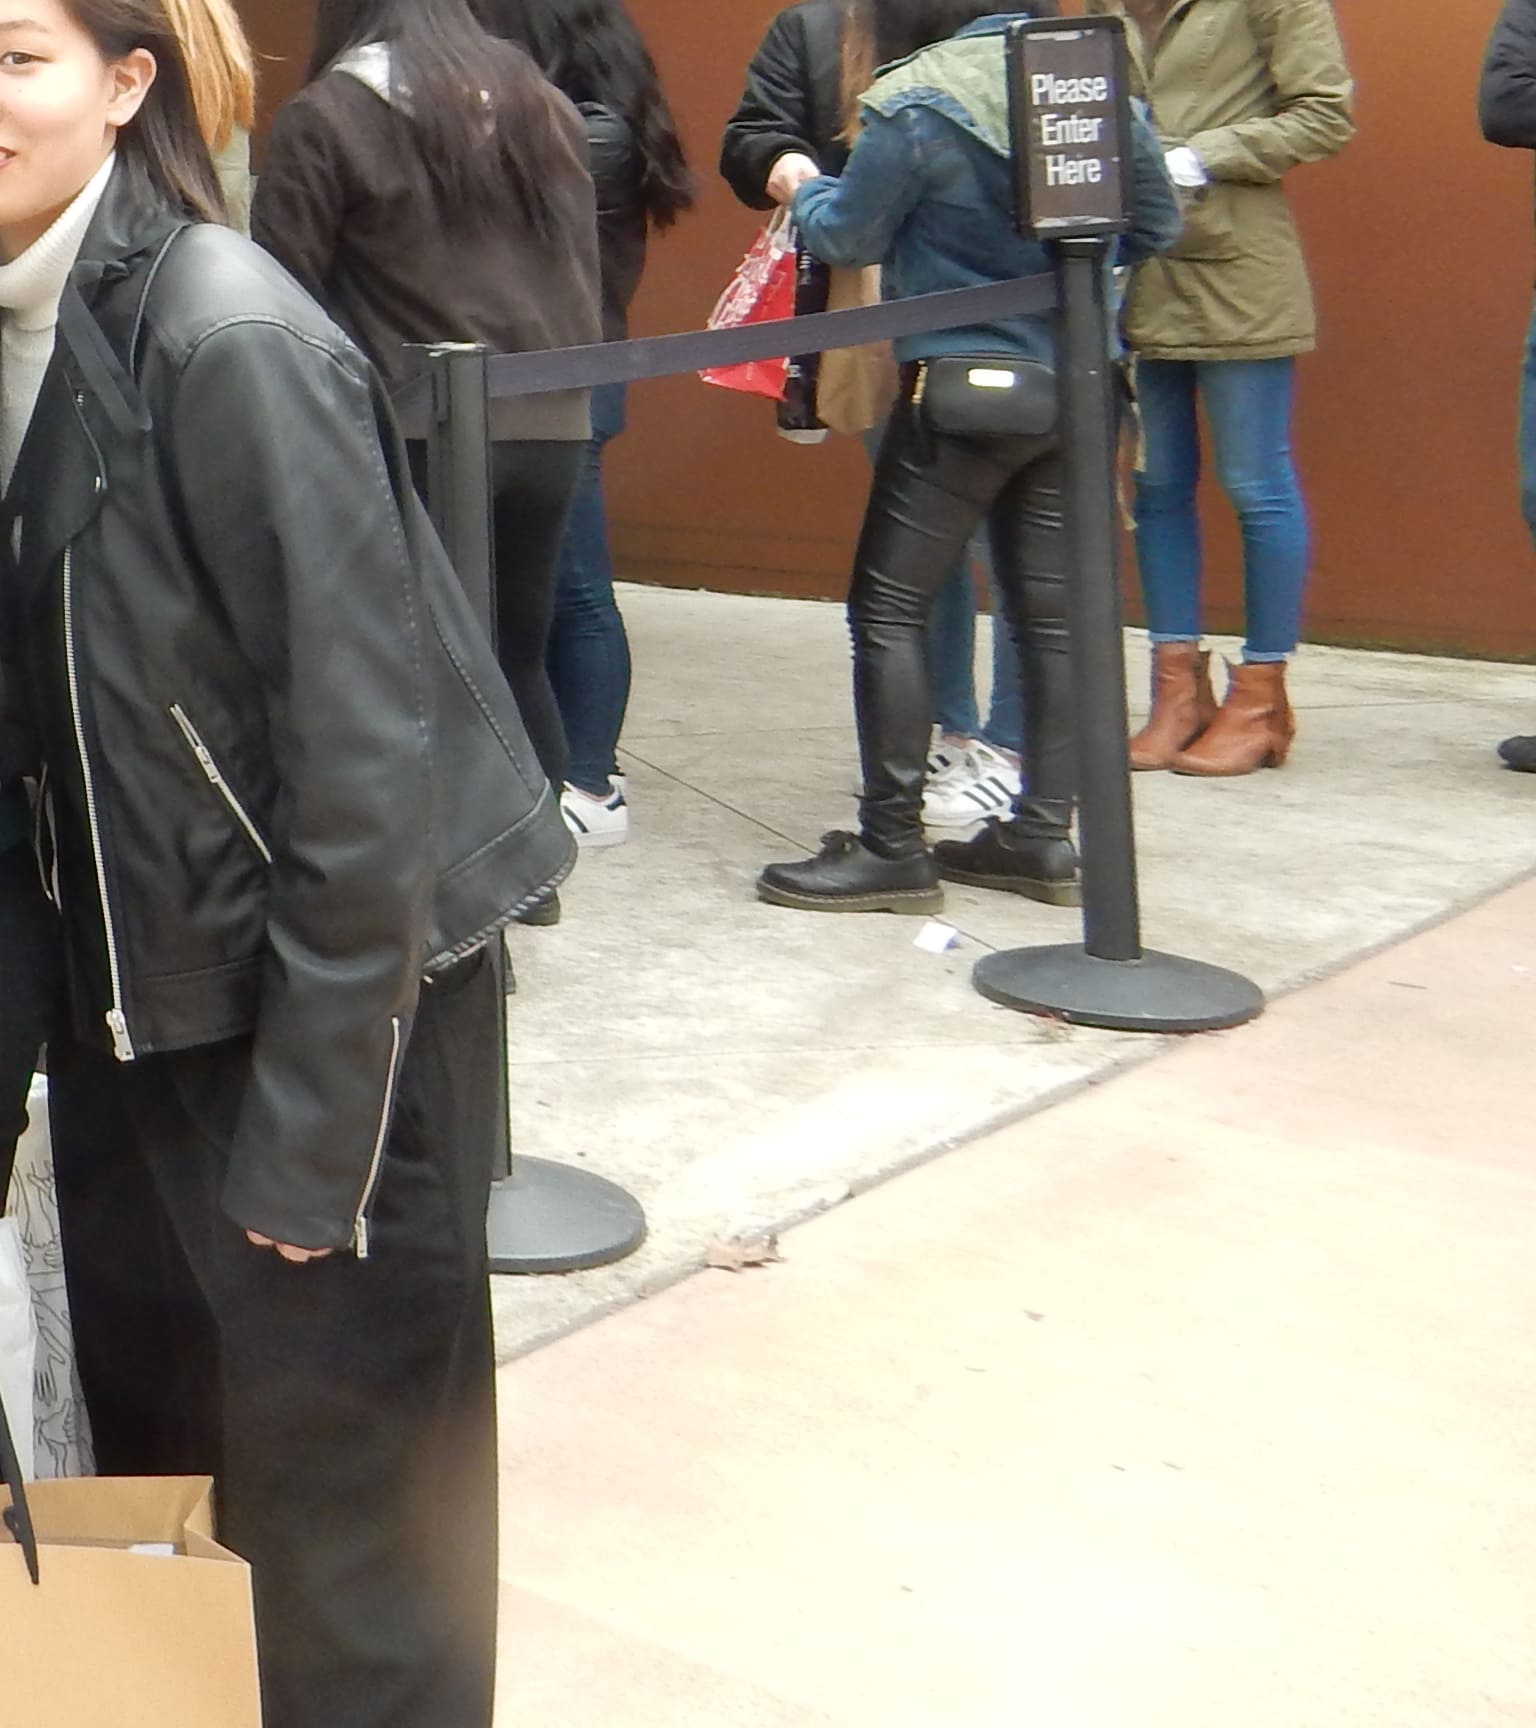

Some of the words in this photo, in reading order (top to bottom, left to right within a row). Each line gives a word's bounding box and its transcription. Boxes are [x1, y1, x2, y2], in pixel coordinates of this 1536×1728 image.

[1031, 73, 1108, 106] Please
[1041, 113, 1103, 146] Enter
[1045, 153, 1103, 186] Here
